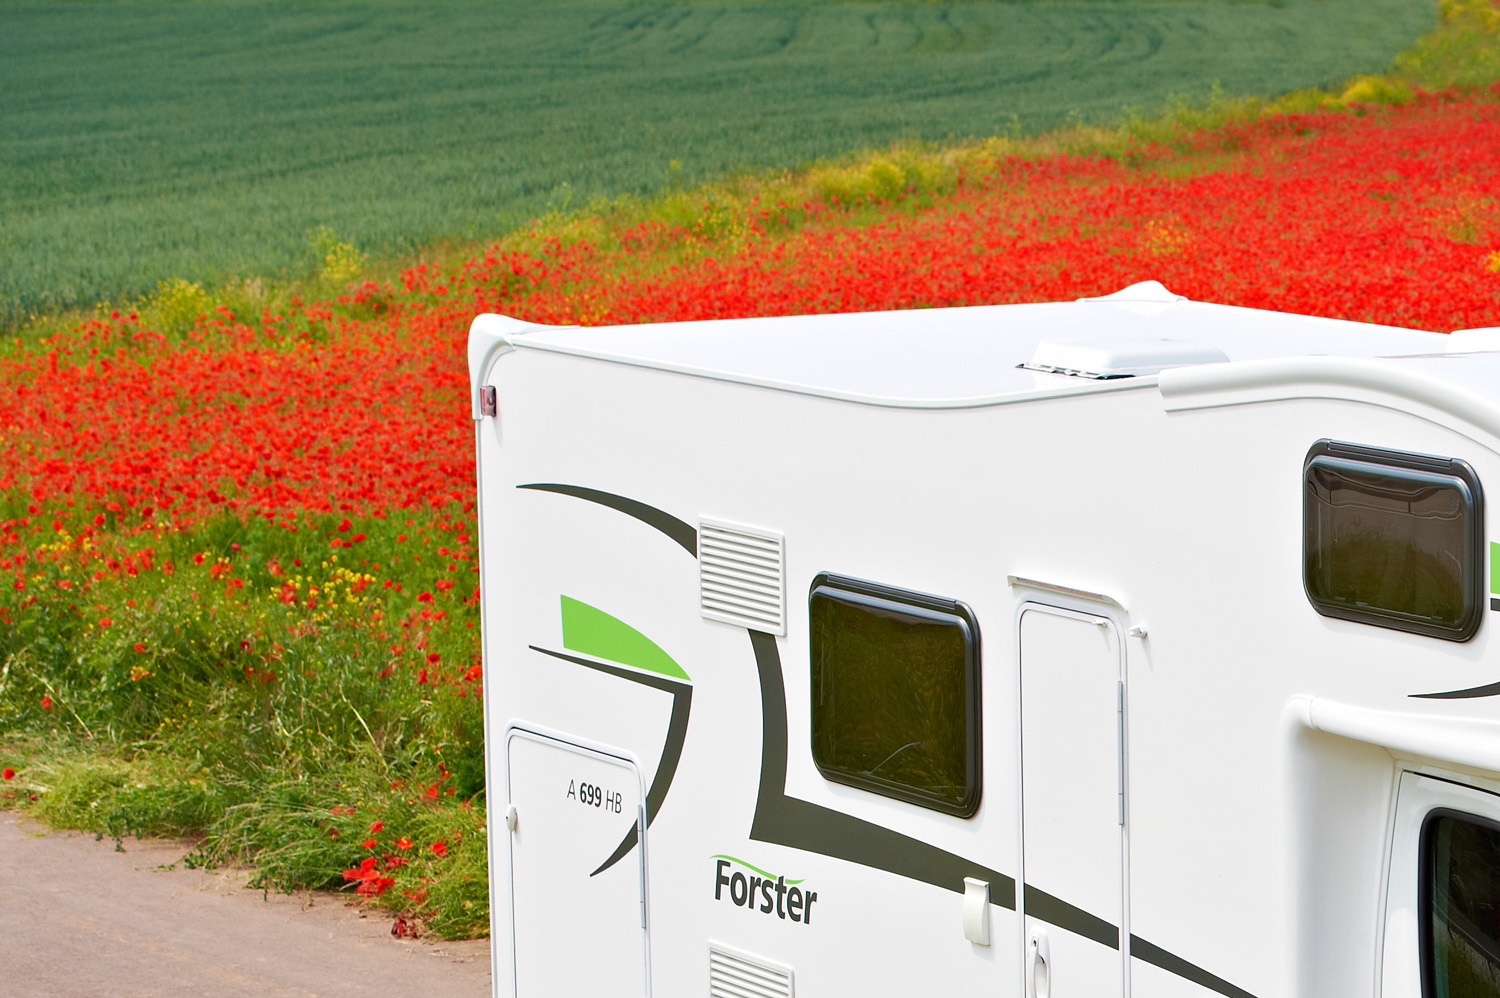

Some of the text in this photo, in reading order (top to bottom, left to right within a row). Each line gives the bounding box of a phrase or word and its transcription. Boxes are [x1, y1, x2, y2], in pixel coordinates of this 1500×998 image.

[566, 778, 623, 814] A 699 HB
[714, 858, 818, 925] Forster
